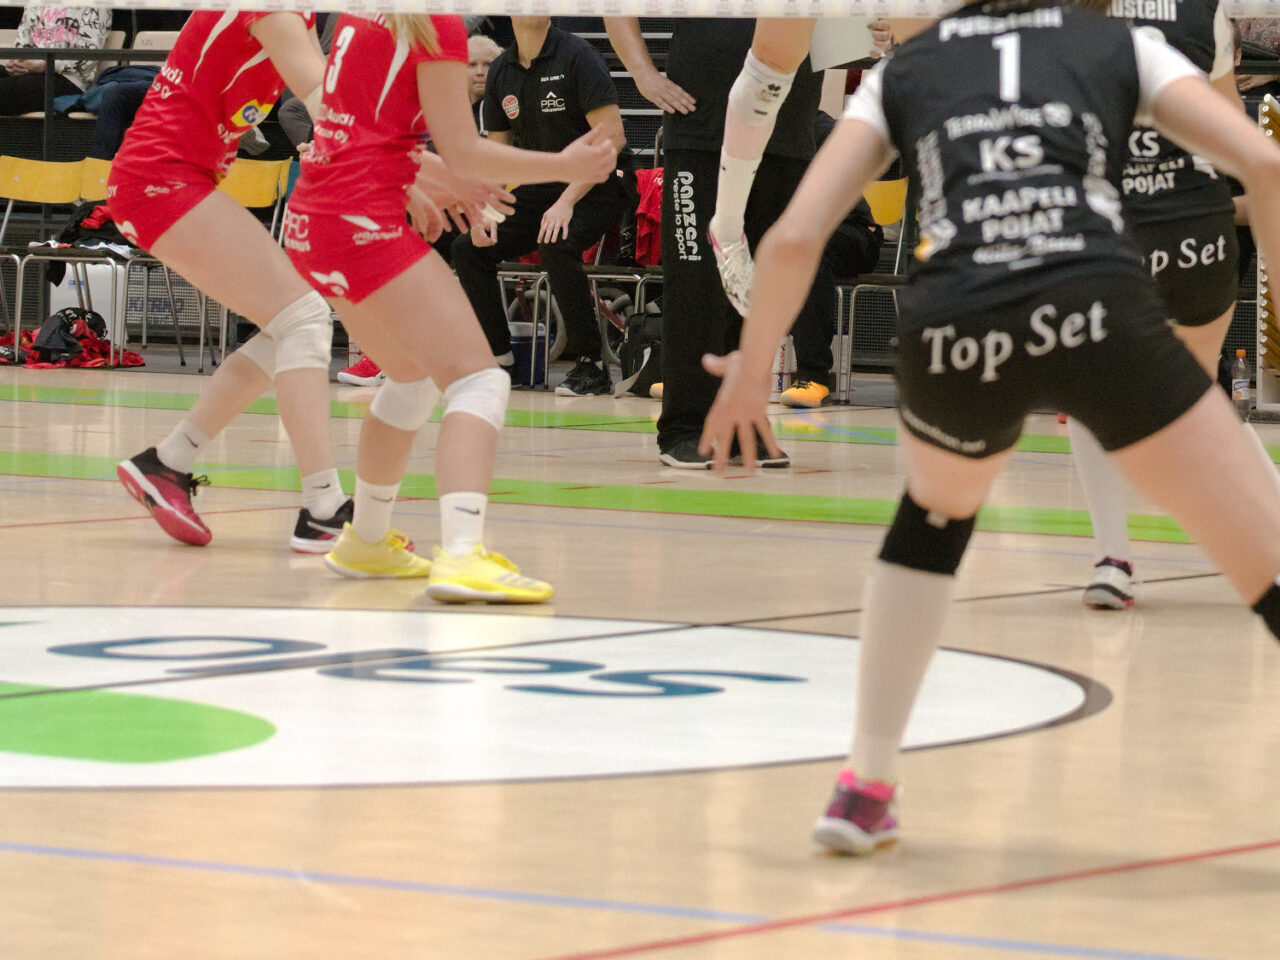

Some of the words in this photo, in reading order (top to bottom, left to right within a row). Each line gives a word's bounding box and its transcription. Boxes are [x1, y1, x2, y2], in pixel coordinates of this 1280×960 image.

[161, 64, 183, 85] udi
[325, 25, 356, 94] 3
[992, 32, 1021, 102] 1
[672, 177, 681, 212] veste
[1121, 172, 1177, 196] POJAT
[677, 171, 702, 261] panzeri
[674, 227, 688, 260] sport
[1177, 234, 1226, 270] Set
[921, 324, 1014, 383] Top
[1025, 300, 1109, 357] Set
